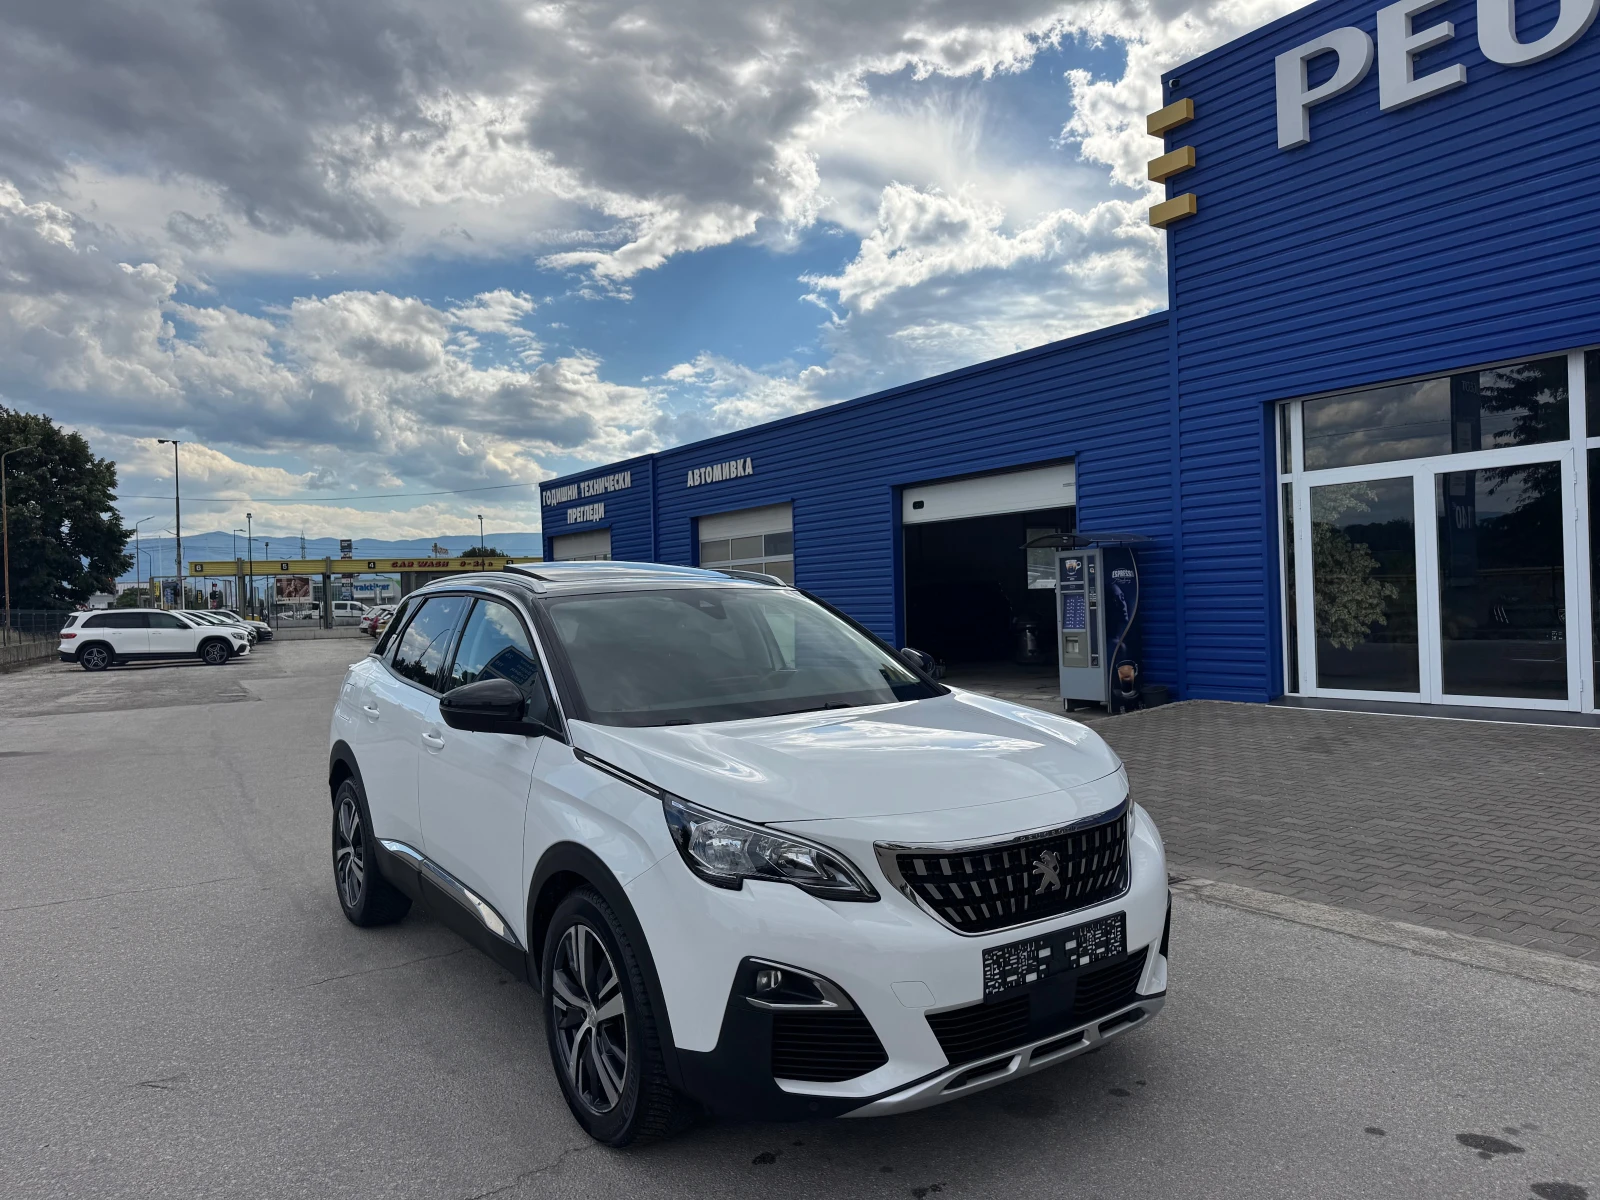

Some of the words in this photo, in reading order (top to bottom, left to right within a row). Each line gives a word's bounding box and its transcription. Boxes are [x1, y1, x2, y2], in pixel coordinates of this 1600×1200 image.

[1275, 0, 1600, 149] PEU
[687, 457, 753, 487] АВТОМИВКА
[542, 484, 578, 507] ГОДИШНИ
[580, 471, 631, 498] ТЕХНИЧЕСКИ
[567, 502, 605, 524] ПРЕГЛЕДИ
[417, 560, 449, 568] WASH
